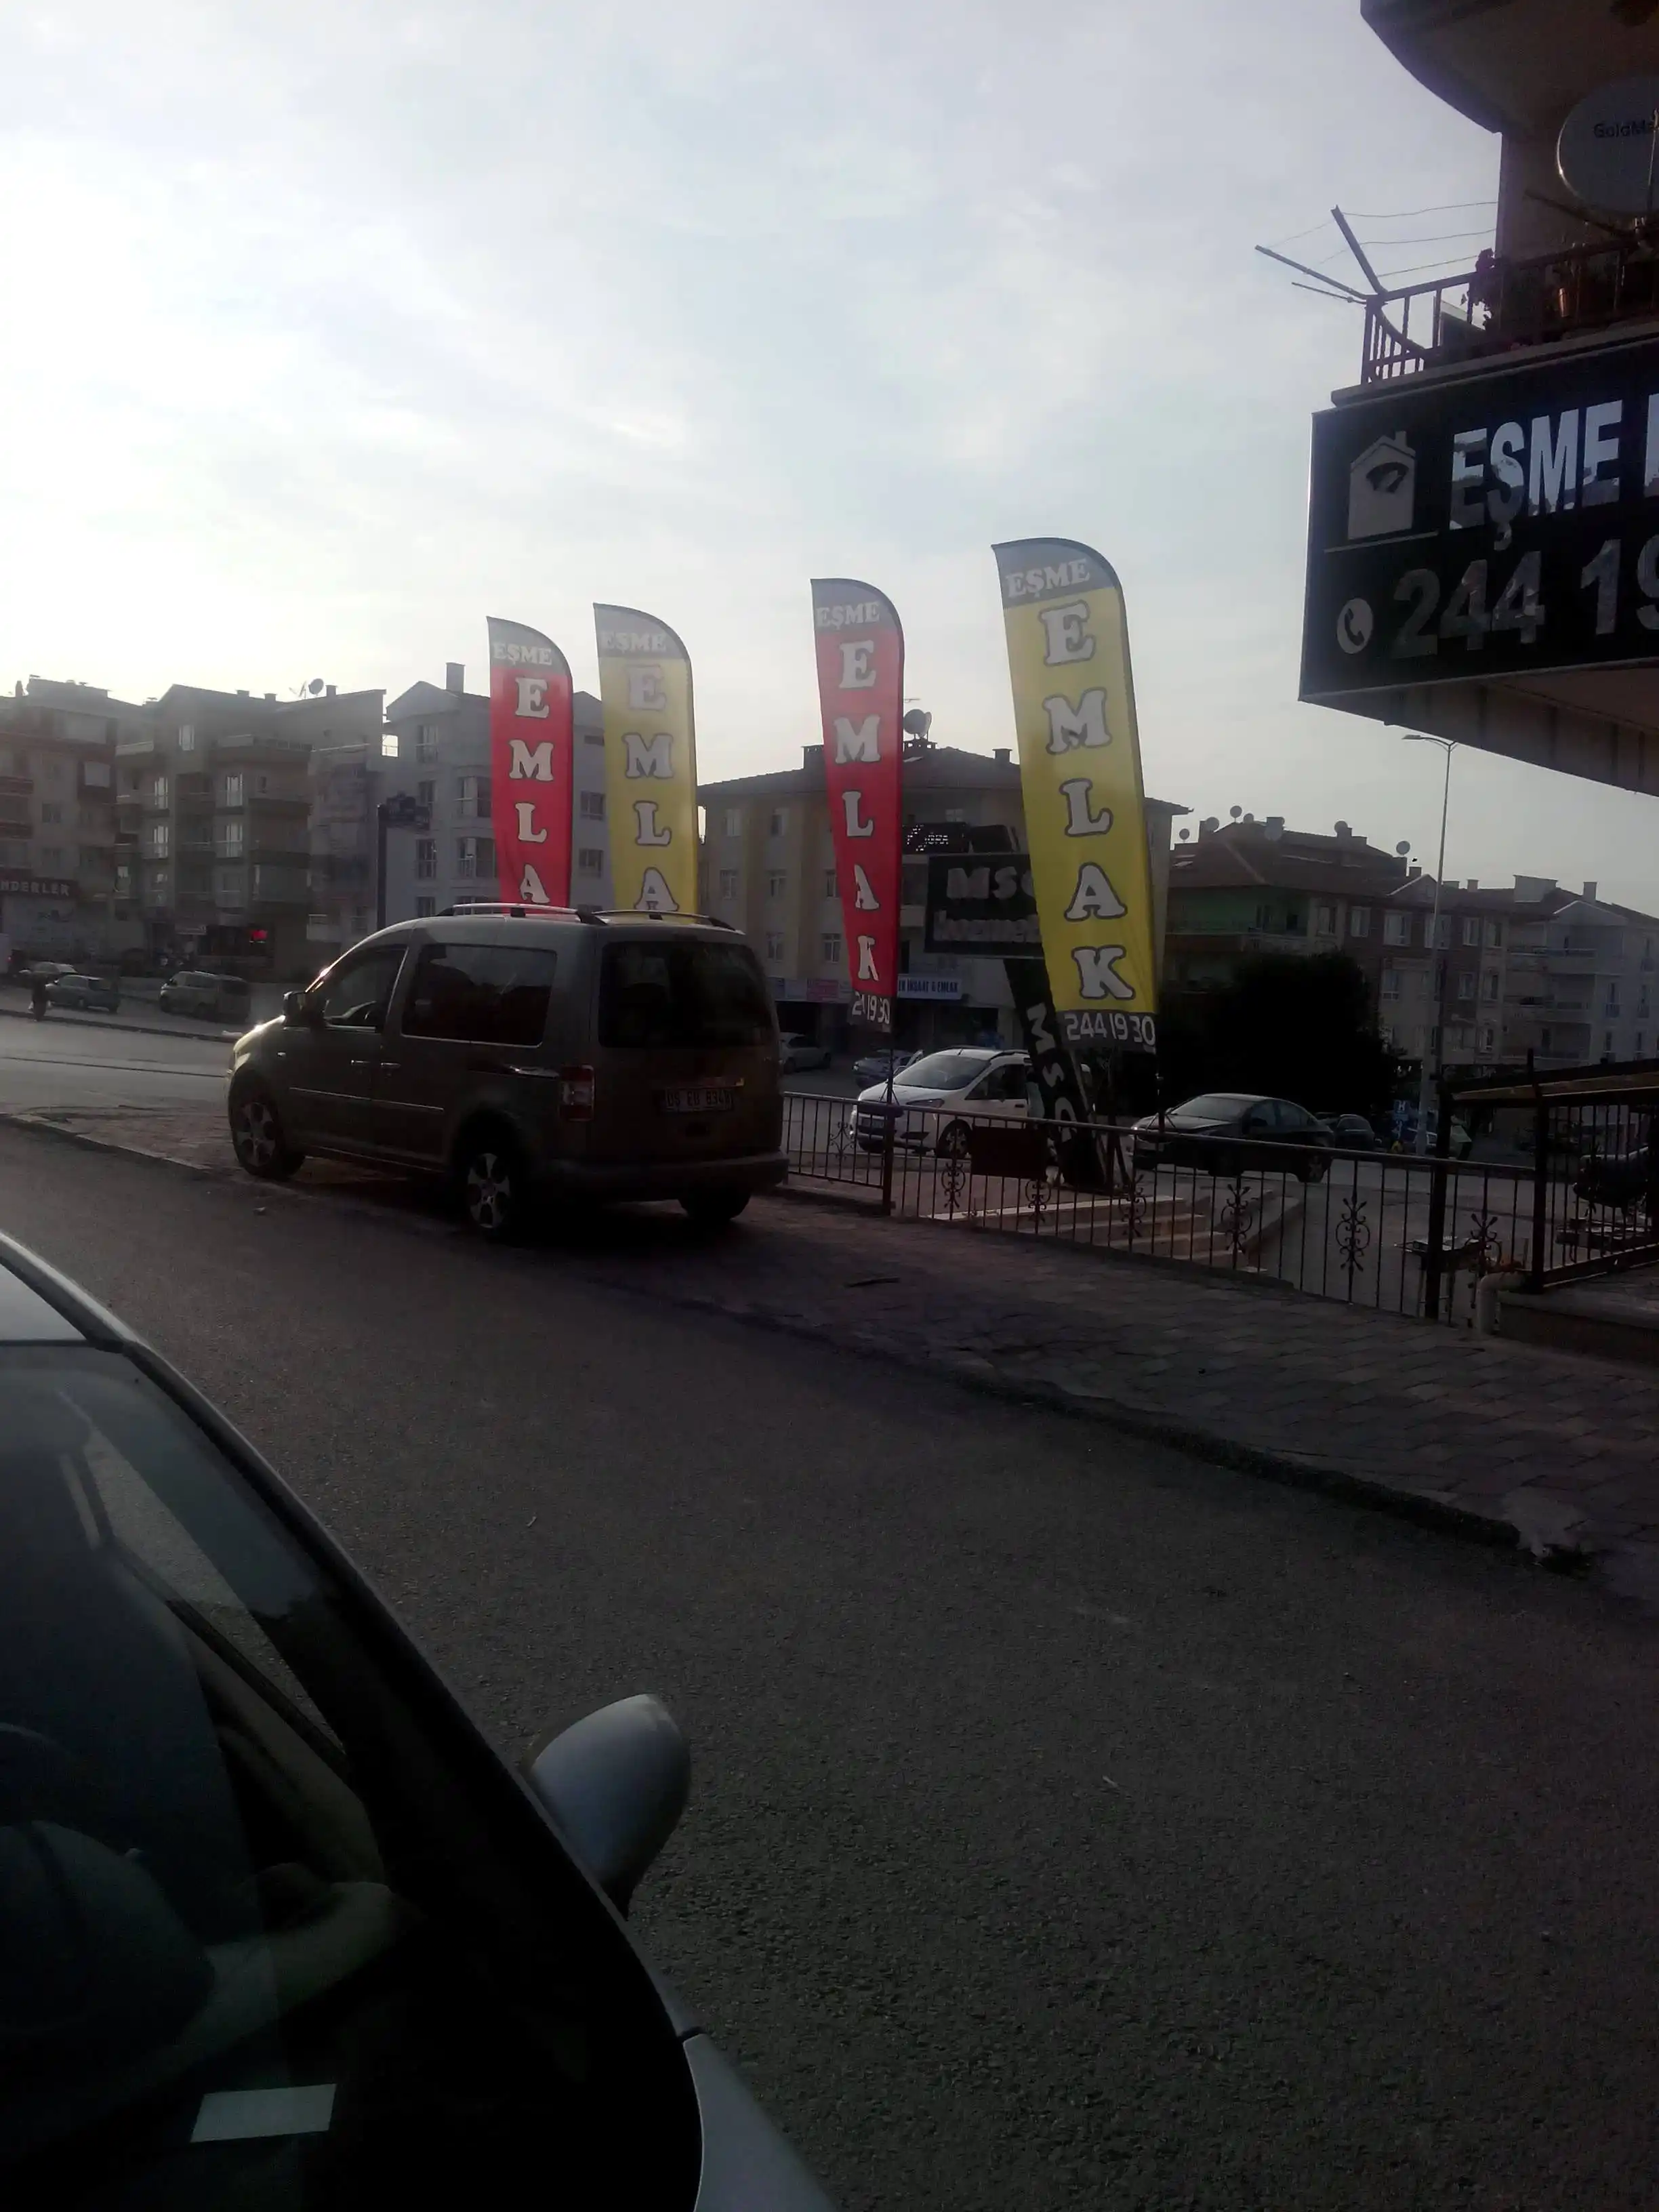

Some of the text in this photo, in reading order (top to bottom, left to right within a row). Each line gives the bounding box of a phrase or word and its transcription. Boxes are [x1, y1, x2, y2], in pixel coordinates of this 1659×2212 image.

[1449, 399, 1623, 550] EŞME
[815, 601, 880, 630] EŞME
[1005, 558, 1092, 598] EŞME
[1391, 551, 1546, 657] 244
[493, 643, 553, 665] EŞME
[601, 632, 667, 653] EŞME
[508, 677, 555, 903] EMLA
[622, 663, 680, 912] EMLA
[1038, 600, 1135, 1000] EMLAK
